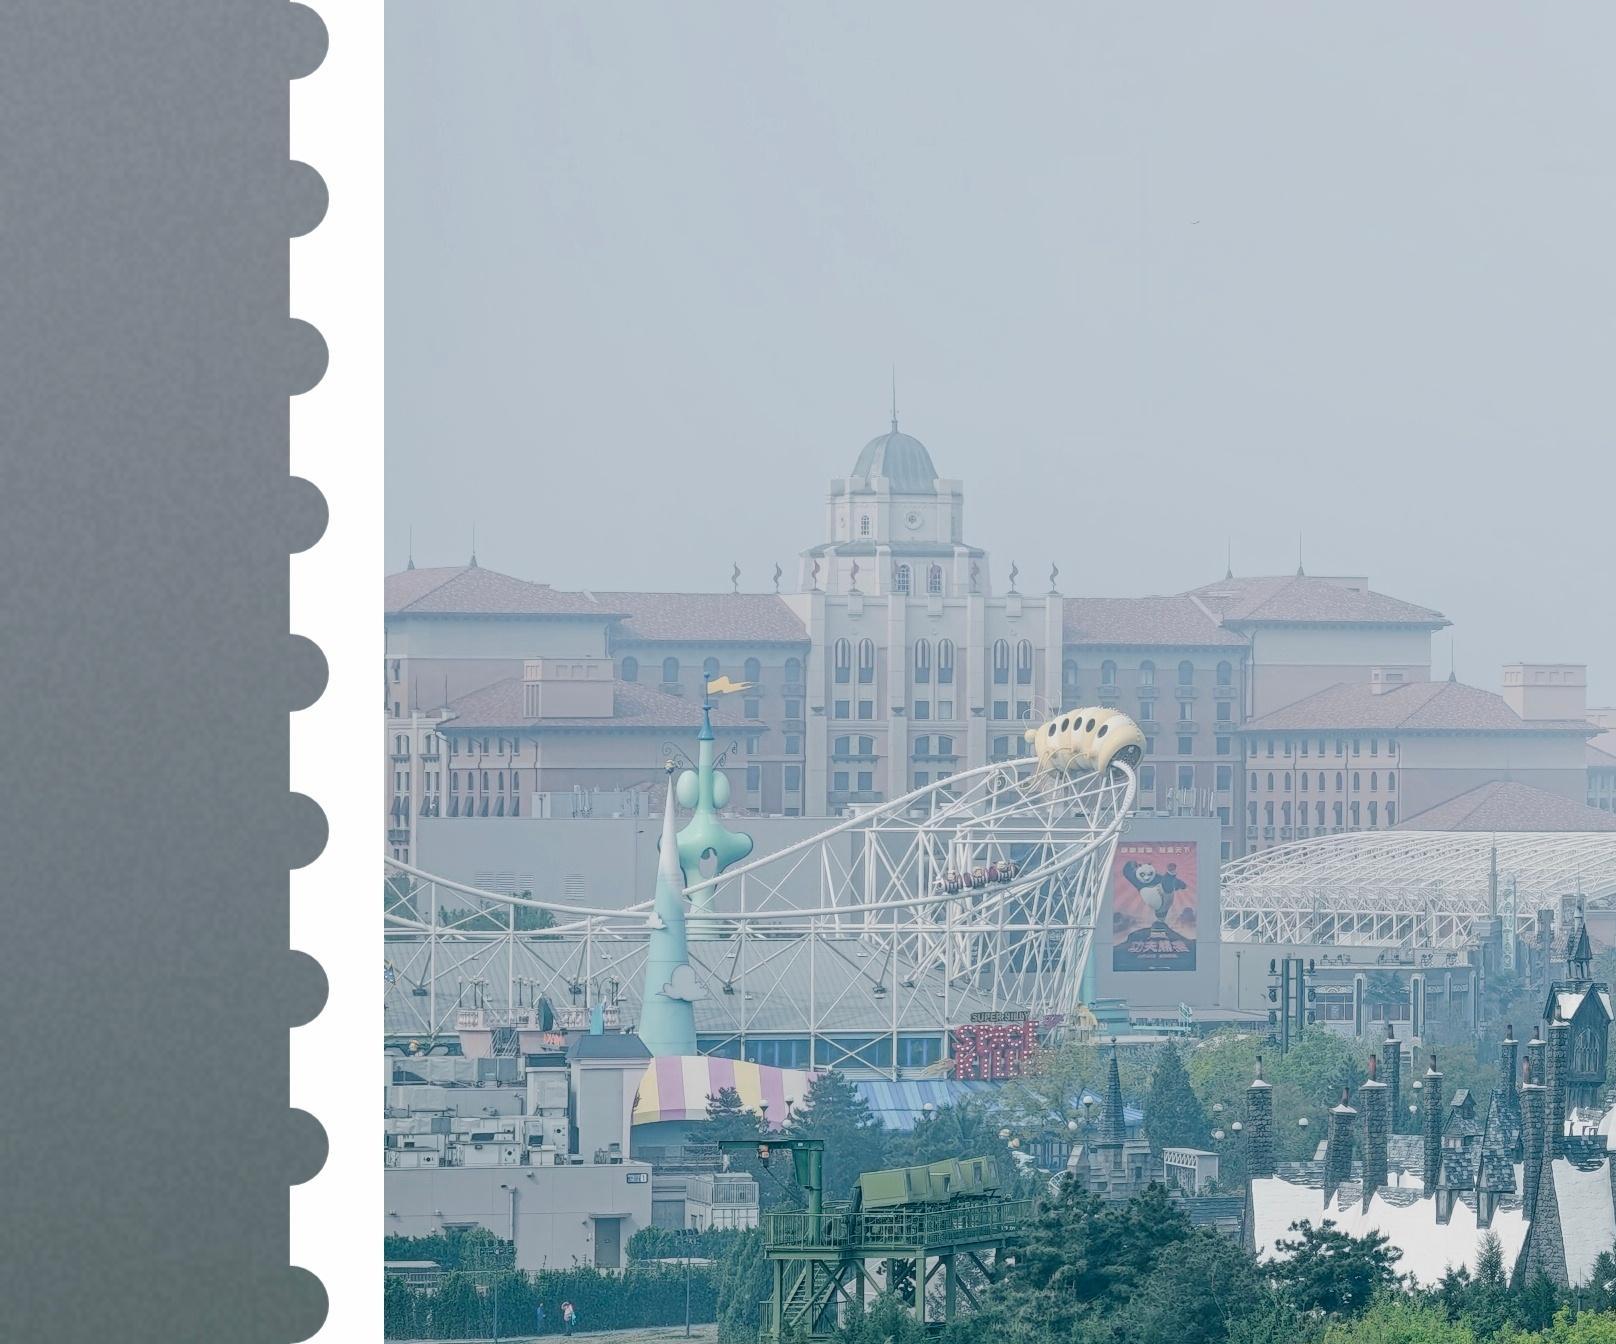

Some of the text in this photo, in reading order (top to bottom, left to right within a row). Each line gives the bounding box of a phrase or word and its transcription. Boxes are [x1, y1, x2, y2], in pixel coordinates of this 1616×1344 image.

[970, 1010, 1031, 1023] SUPER SILLY
[952, 1020, 1040, 1056] SPACE
